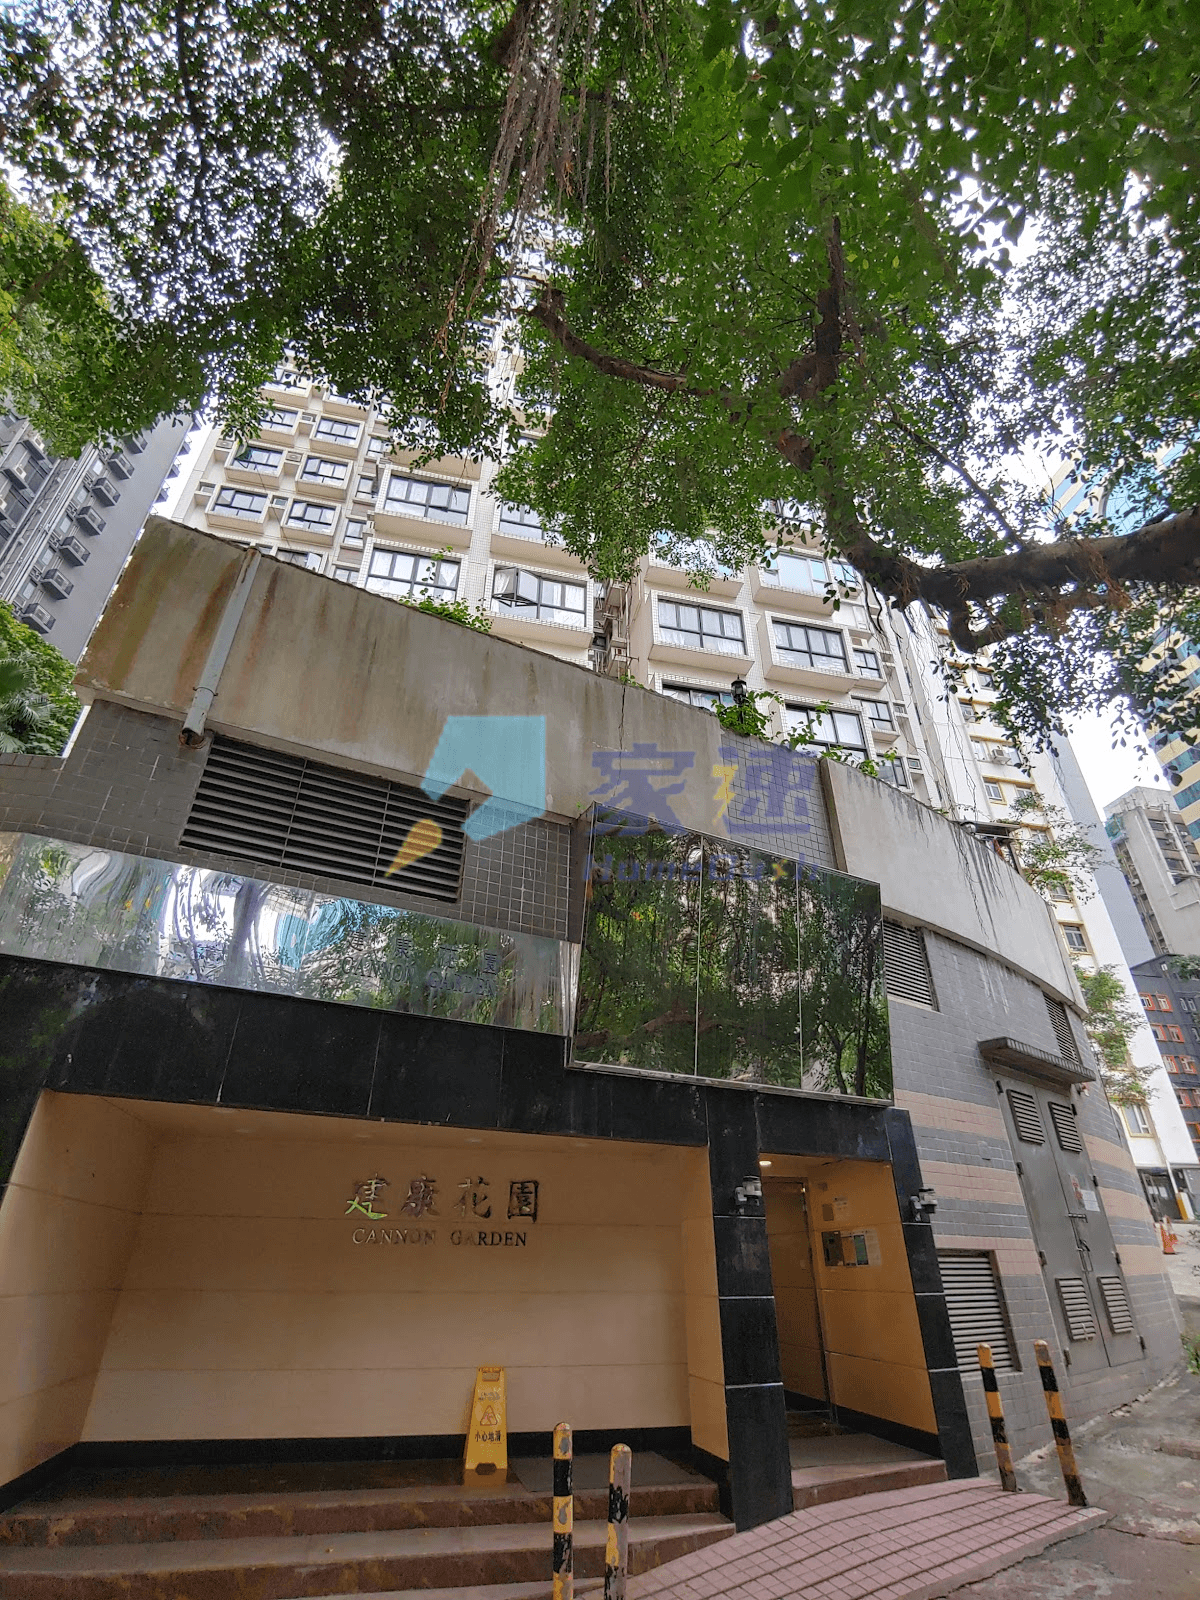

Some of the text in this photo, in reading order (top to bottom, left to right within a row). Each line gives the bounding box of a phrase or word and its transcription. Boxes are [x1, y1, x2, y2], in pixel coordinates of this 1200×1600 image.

[341, 956, 497, 997] CANNON GARDEN
[352, 1228, 527, 1247] CANNON GARDEN
